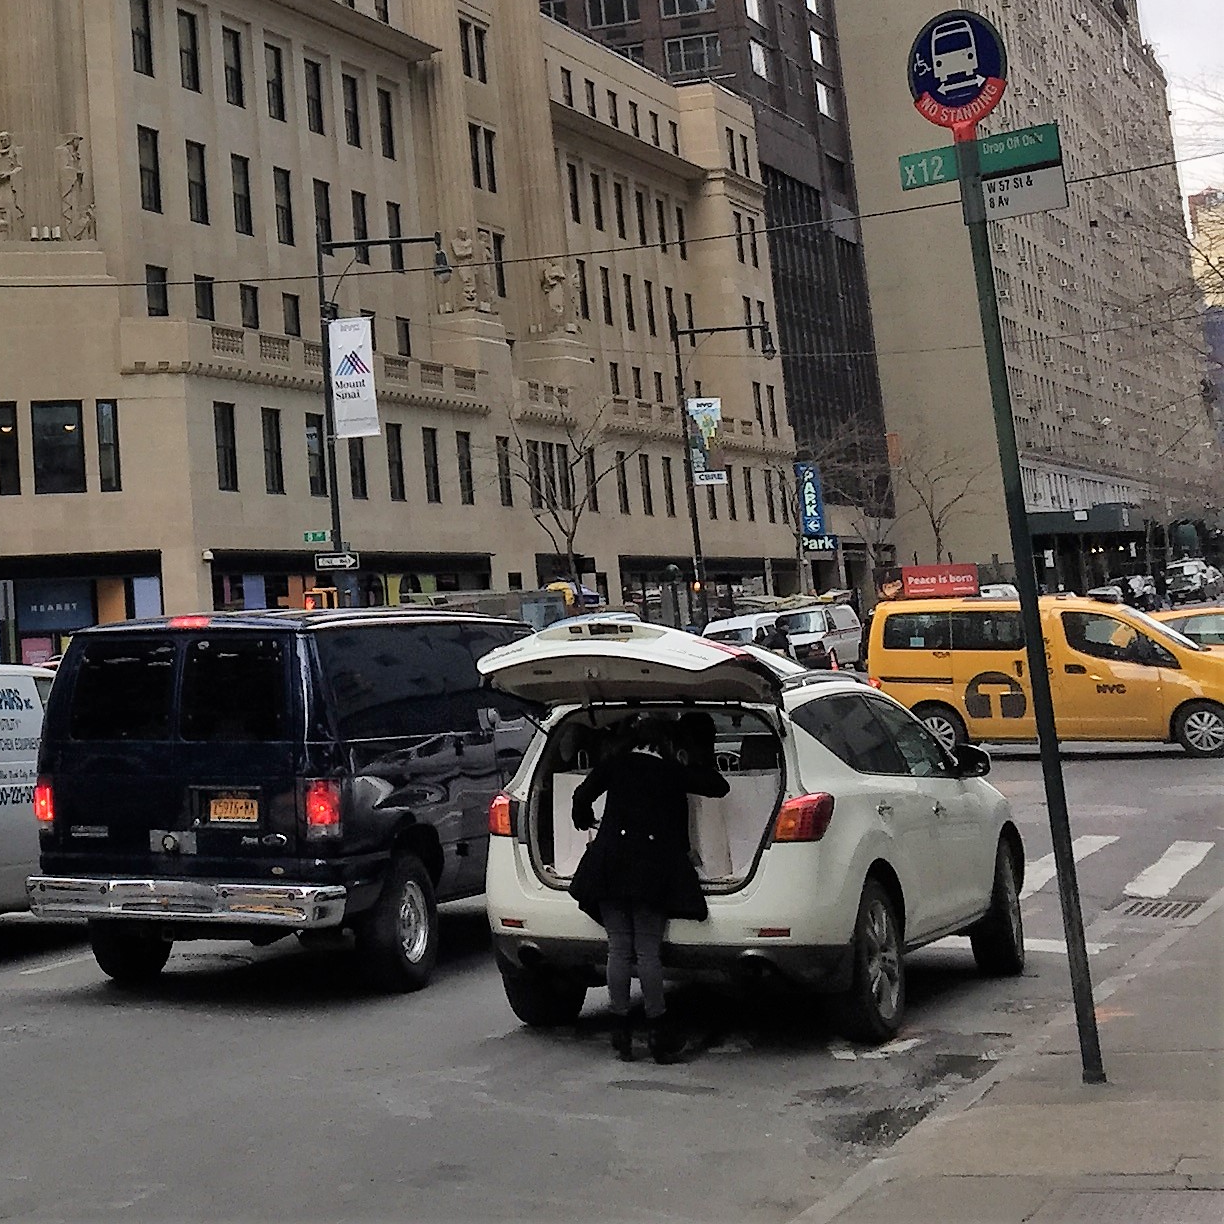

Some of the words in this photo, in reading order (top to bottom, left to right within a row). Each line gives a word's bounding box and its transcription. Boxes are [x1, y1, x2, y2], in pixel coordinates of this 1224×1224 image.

[921, 95, 939, 116] NO
[941, 83, 998, 123] STANDING
[983, 140, 1005, 155] Drop
[1006, 138, 1021, 150] Off
[987, 182, 996, 194] W
[999, 179, 1010, 192] 57
[1013, 178, 1023, 189] St
[1026, 175, 1033, 186] &
[989, 196, 995, 209] 8
[998, 195, 1010, 207] Av
[335, 379, 366, 389] Mount
[335, 389, 361, 400] Sinai
[699, 473, 724, 481] CBRE
[803, 467, 819, 517] PARK
[908, 576, 936, 585] Peace
[938, 575, 947, 584] is
[949, 574, 973, 583] born
[1096, 684, 1127, 694] NYC
